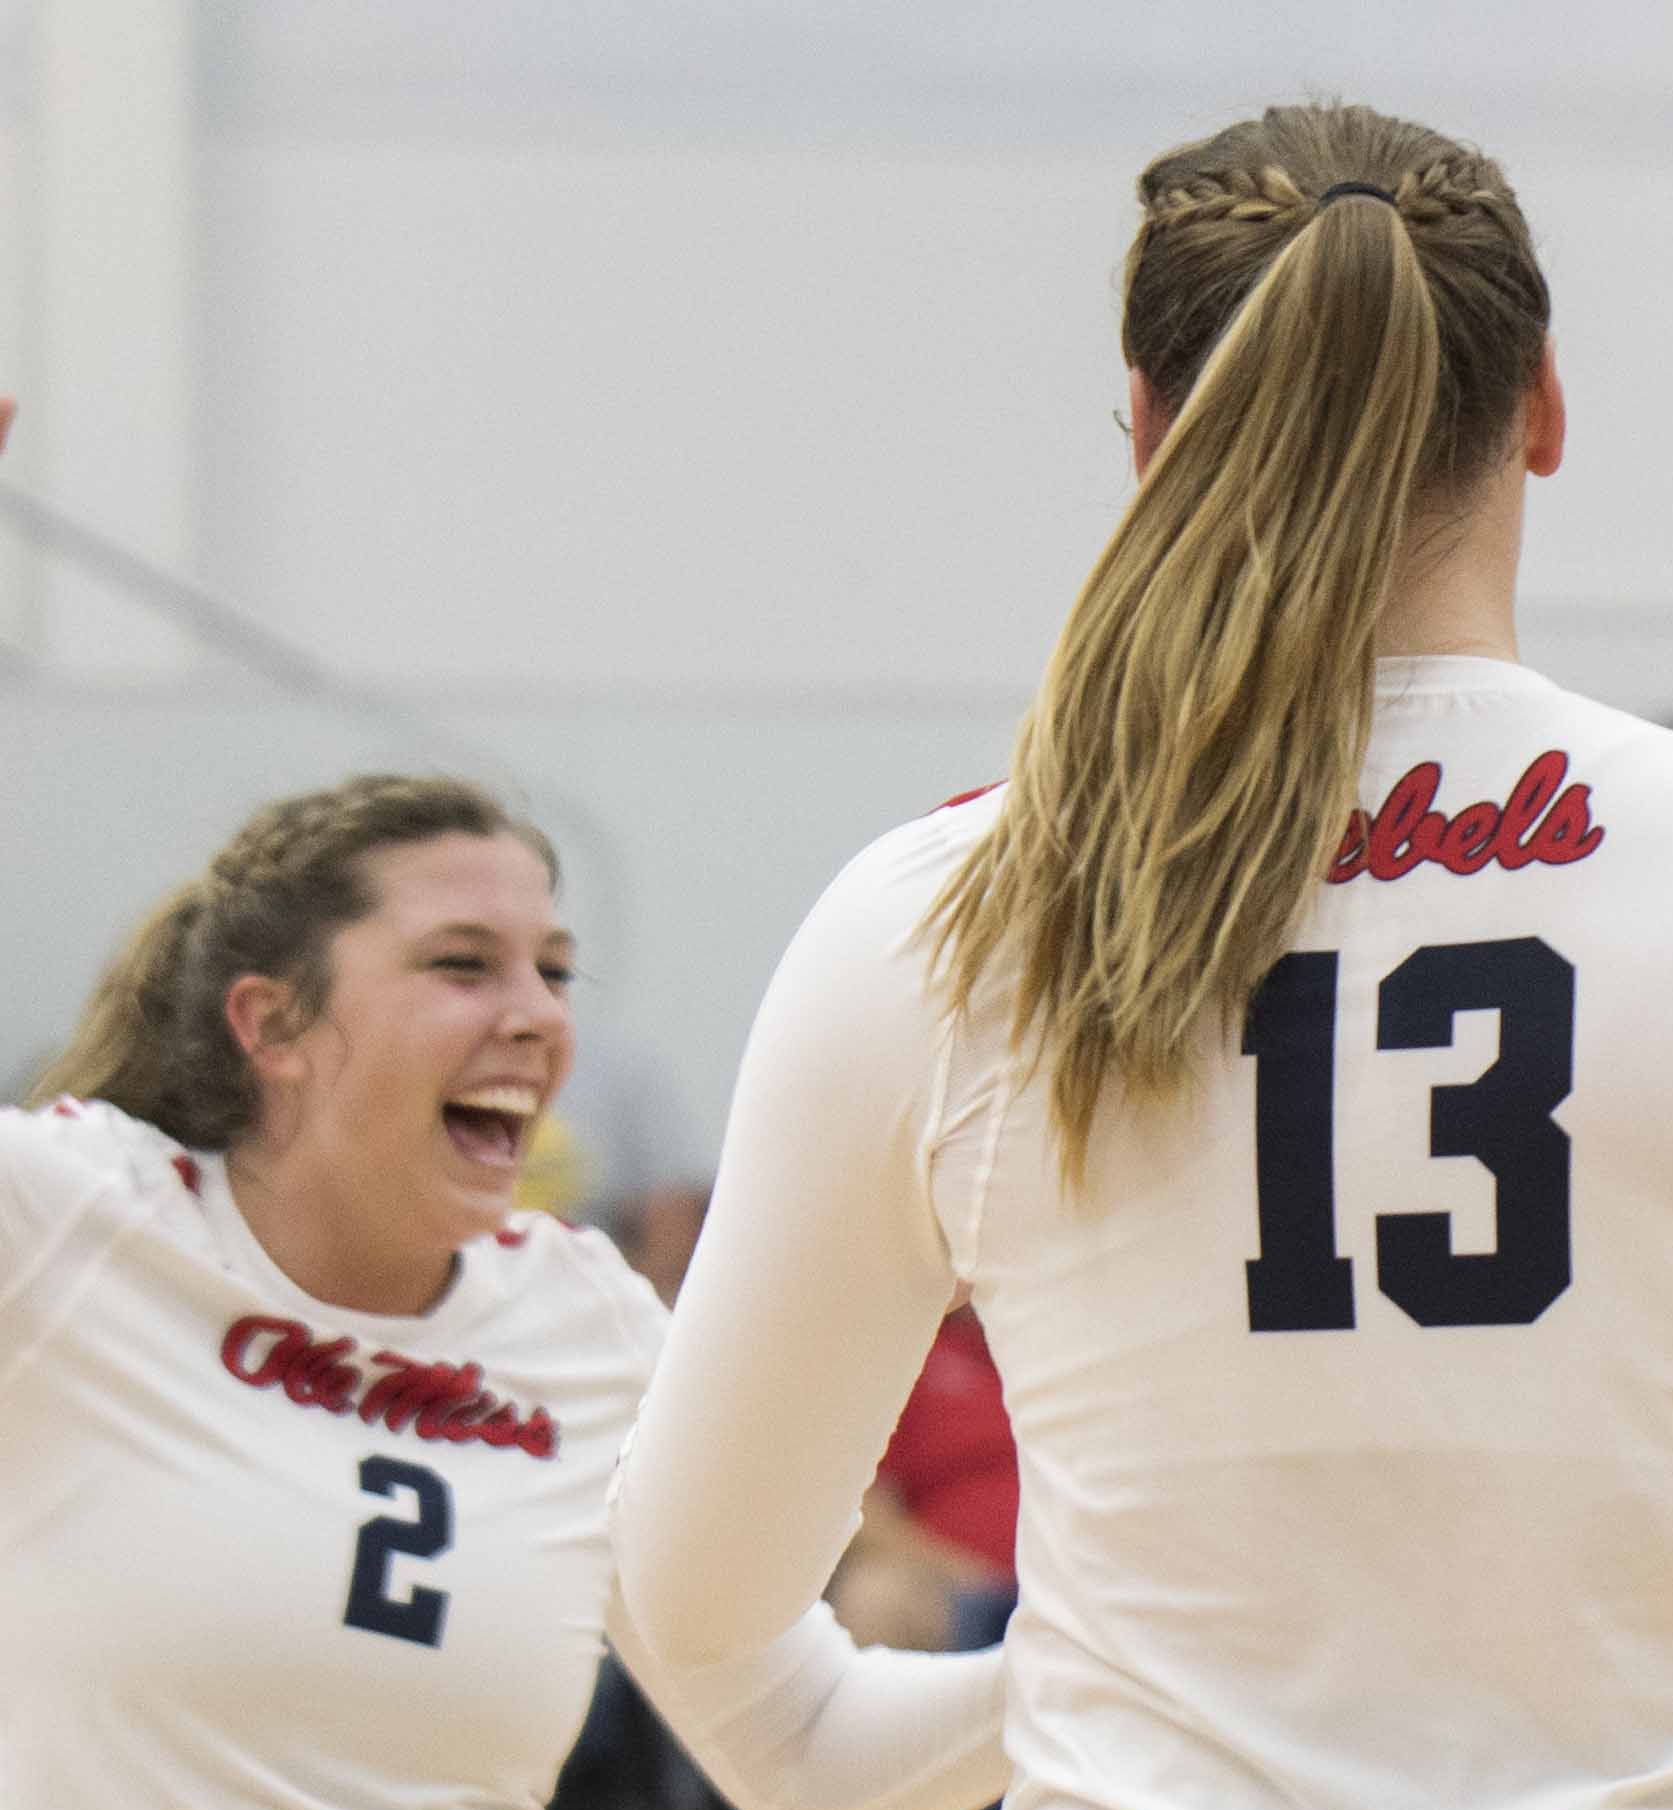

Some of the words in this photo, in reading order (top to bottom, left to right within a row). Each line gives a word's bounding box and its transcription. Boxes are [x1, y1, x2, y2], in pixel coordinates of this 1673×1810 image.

[1326, 750, 1606, 884] ebels
[1241, 936, 1575, 1332] 13
[222, 1315, 360, 1415] Ole
[358, 1350, 561, 1461] Miss
[344, 1453, 455, 1649] 2
